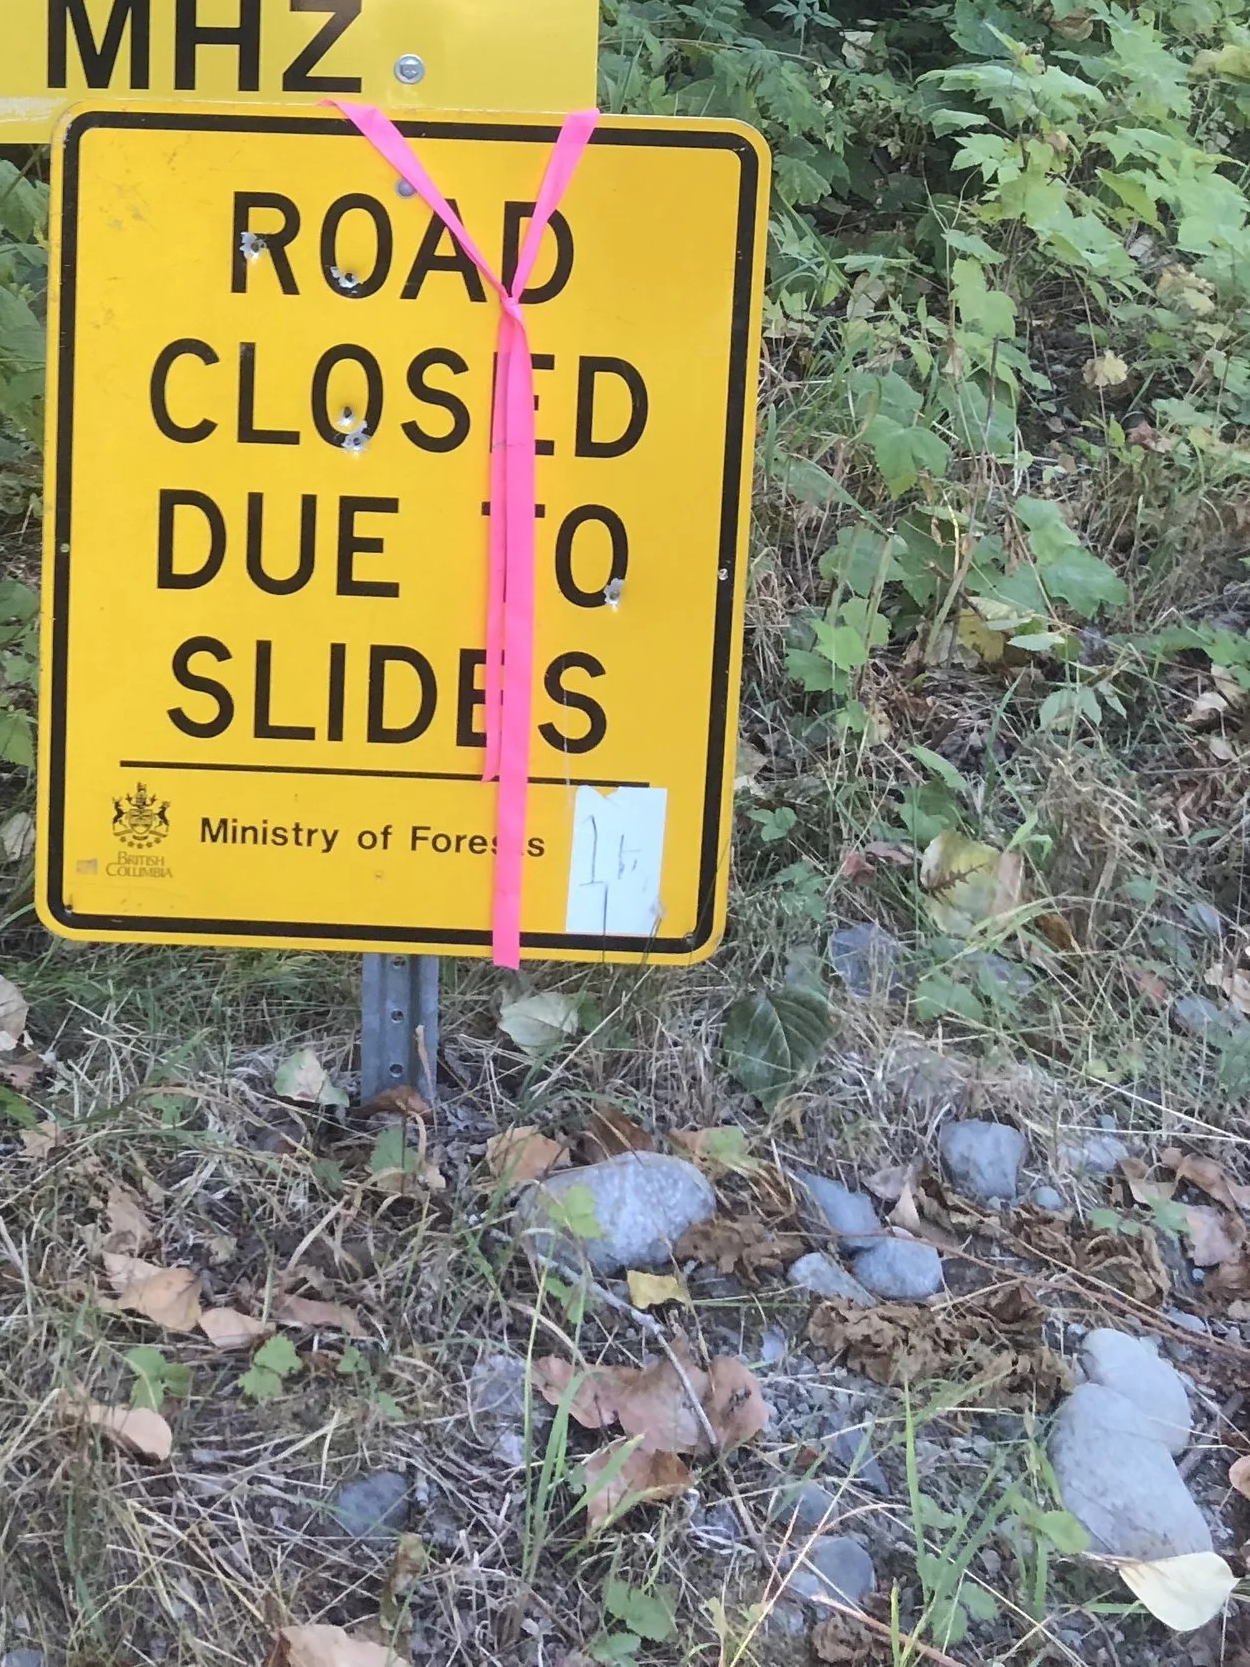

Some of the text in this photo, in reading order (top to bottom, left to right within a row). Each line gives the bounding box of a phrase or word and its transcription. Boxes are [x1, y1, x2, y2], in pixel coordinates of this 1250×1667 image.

[232, 192, 573, 304] ROAD
[158, 489, 399, 597] DUE
[201, 817, 339, 853] Ministry
[358, 825, 392, 850] of
[106, 862, 173, 878] COLUMBIA
[117, 851, 165, 866] BRITISH
